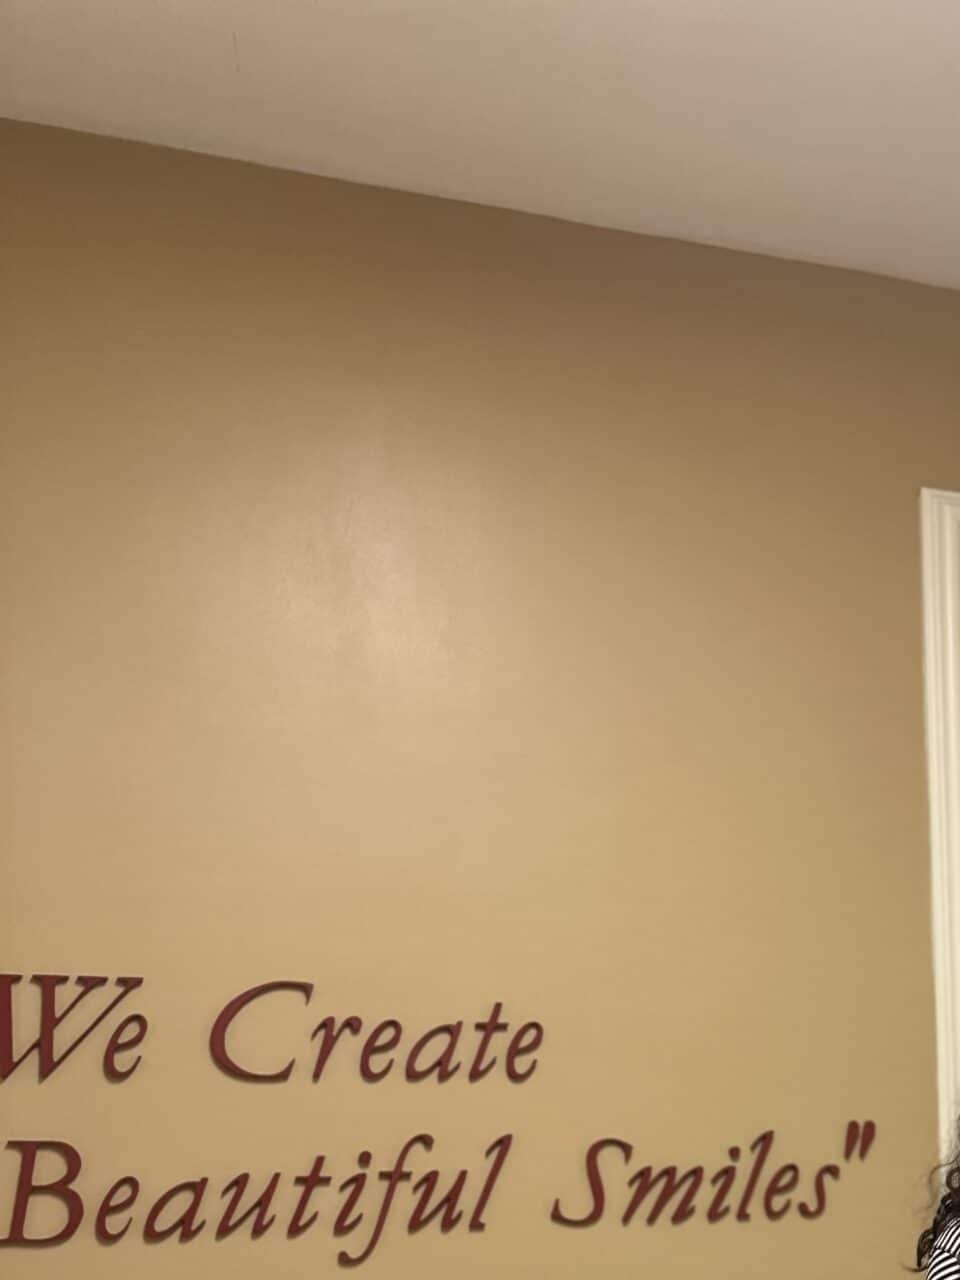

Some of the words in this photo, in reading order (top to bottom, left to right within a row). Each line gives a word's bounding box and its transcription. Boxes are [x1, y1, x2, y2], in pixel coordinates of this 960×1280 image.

[0, 973, 149, 1084] We
[208, 980, 545, 1084] Create
[0, 1133, 514, 1268] Beautiful
[551, 1120, 877, 1229] Smiles"
